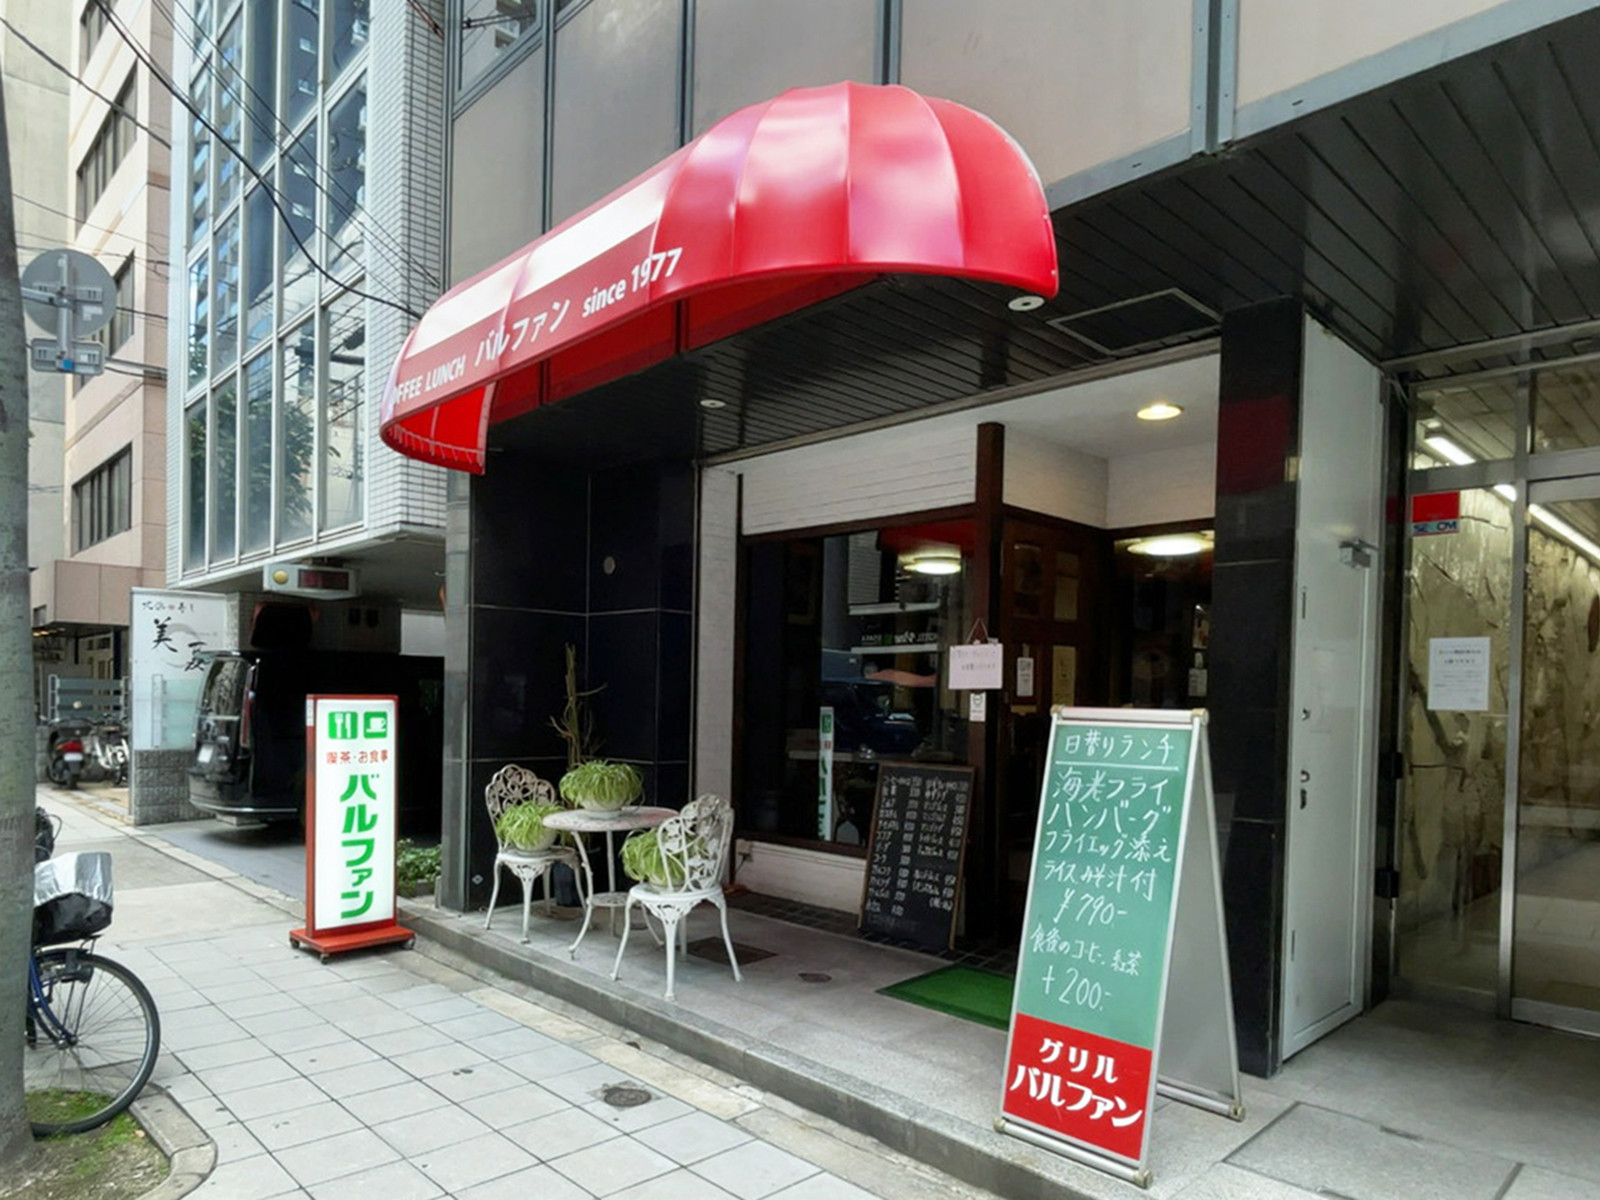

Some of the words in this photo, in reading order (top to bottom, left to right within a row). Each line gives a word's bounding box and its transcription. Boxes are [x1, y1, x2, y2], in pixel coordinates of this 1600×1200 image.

[424, 354, 466, 393] LUNCH
[474, 298, 571, 368] バルファン
[582, 278, 627, 318] since
[630, 247, 683, 293] 1977
[326, 749, 389, 765] 喫茶・お食事
[1064, 729, 1175, 765] 日替りランチ
[1052, 766, 1169, 806] 海老フライ
[1046, 800, 1172, 833] ハンバーグ
[340, 773, 380, 920] バルファン
[1042, 829, 1172, 862] フライエッグ添え
[1039, 1037, 1119, 1085] グリル
[1009, 1064, 1143, 1128] バルファン
